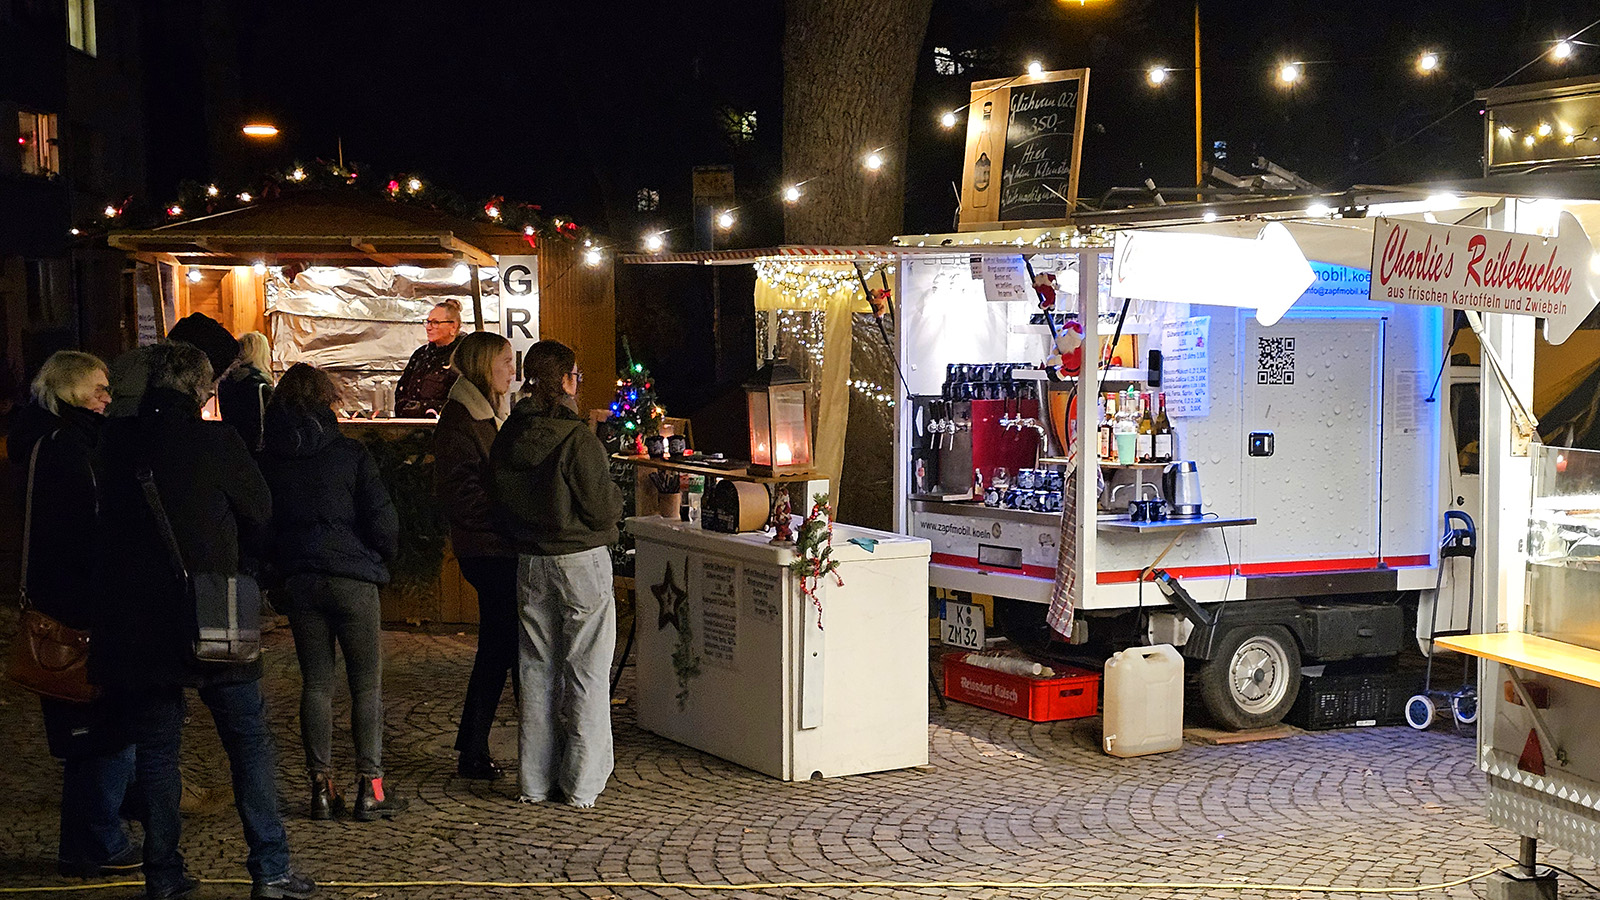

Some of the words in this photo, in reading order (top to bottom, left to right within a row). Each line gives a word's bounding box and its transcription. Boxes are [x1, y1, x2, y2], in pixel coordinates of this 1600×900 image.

[1380, 224, 1454, 286] Charlie's
[1464, 234, 1573, 295] Reibekuchen
[1313, 266, 1371, 283] mobil.koe
[1387, 286, 1405, 299] aus
[1408, 286, 1448, 304] frischen
[1452, 290, 1501, 309] Kartoffeln
[1504, 297, 1522, 311] und
[1525, 298, 1567, 315] Zwiebeln
[920, 521, 991, 539] www.zapfmobil.koeln
[956, 605, 964, 625] K
